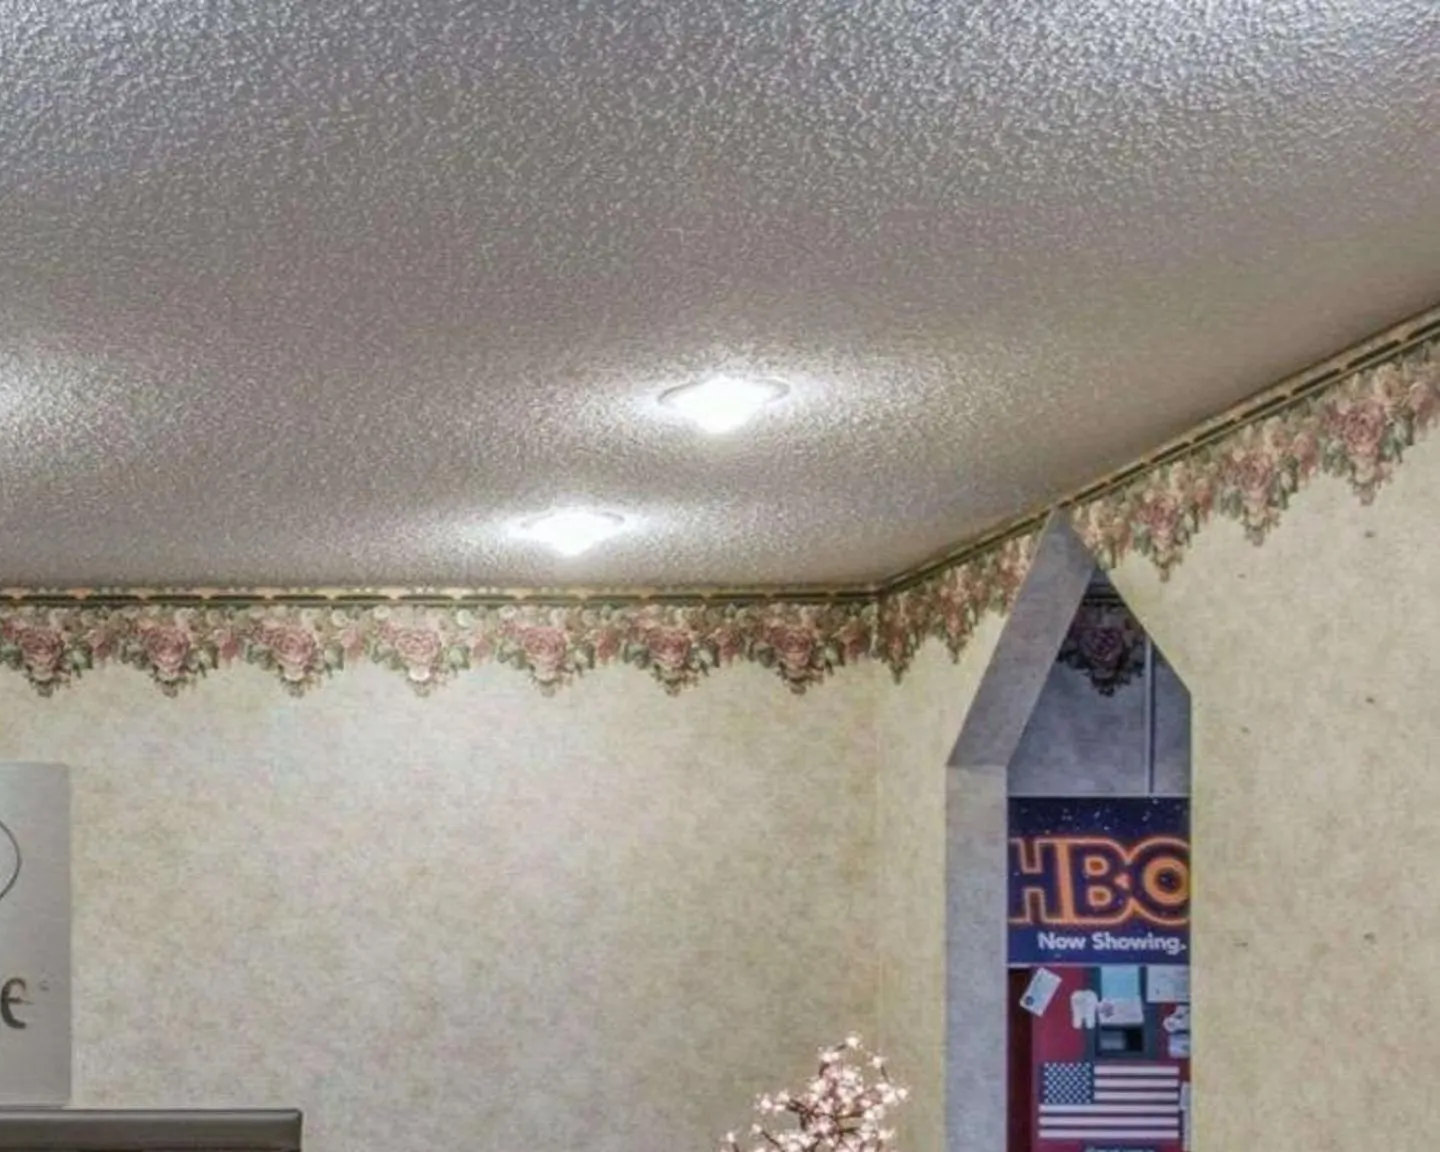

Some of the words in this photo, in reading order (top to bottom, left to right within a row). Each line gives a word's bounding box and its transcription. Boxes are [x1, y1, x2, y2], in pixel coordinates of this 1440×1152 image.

[1008, 836, 1190, 925] HBO
[1037, 931, 1086, 950] Now
[1092, 931, 1187, 955] Showing.
